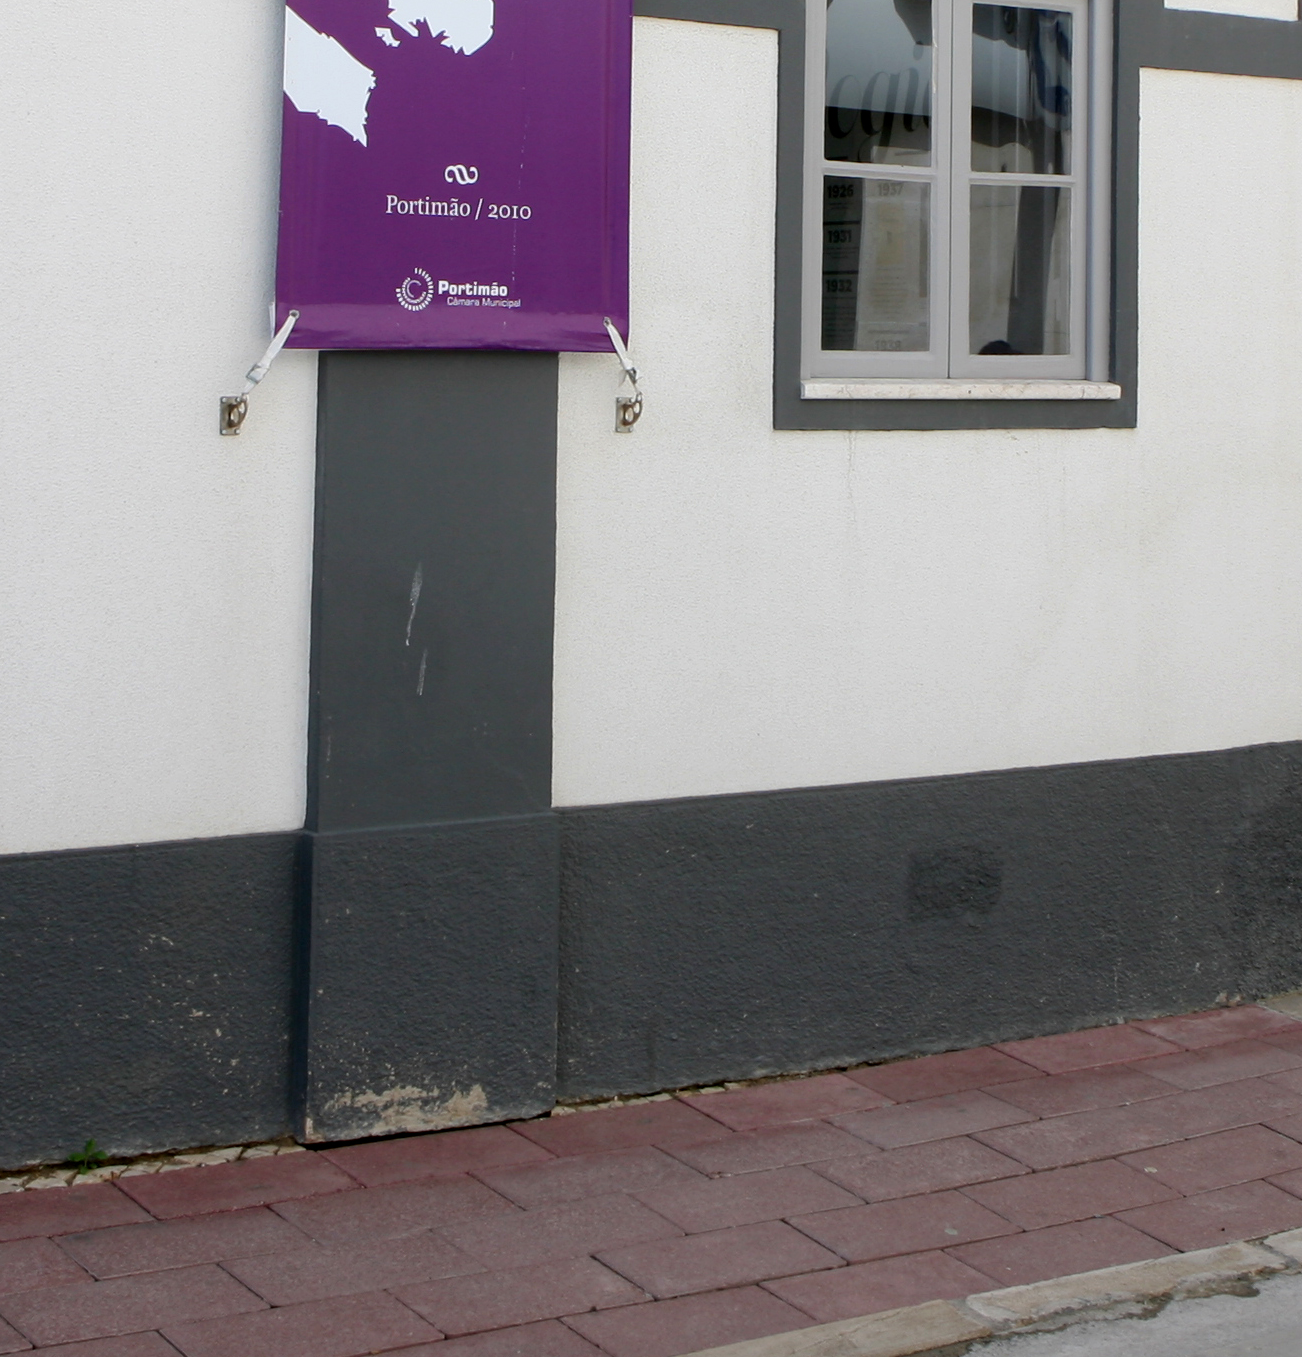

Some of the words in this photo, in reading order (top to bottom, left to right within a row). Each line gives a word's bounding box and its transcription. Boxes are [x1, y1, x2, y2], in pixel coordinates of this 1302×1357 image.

[827, 184, 854, 198] 1926
[385, 194, 471, 217] Portimão
[474, 198, 484, 221] /
[487, 204, 532, 220] 2010
[438, 280, 509, 297] Portimão
[447, 296, 480, 307] Câmara
[481, 298, 521, 310] Municipal
